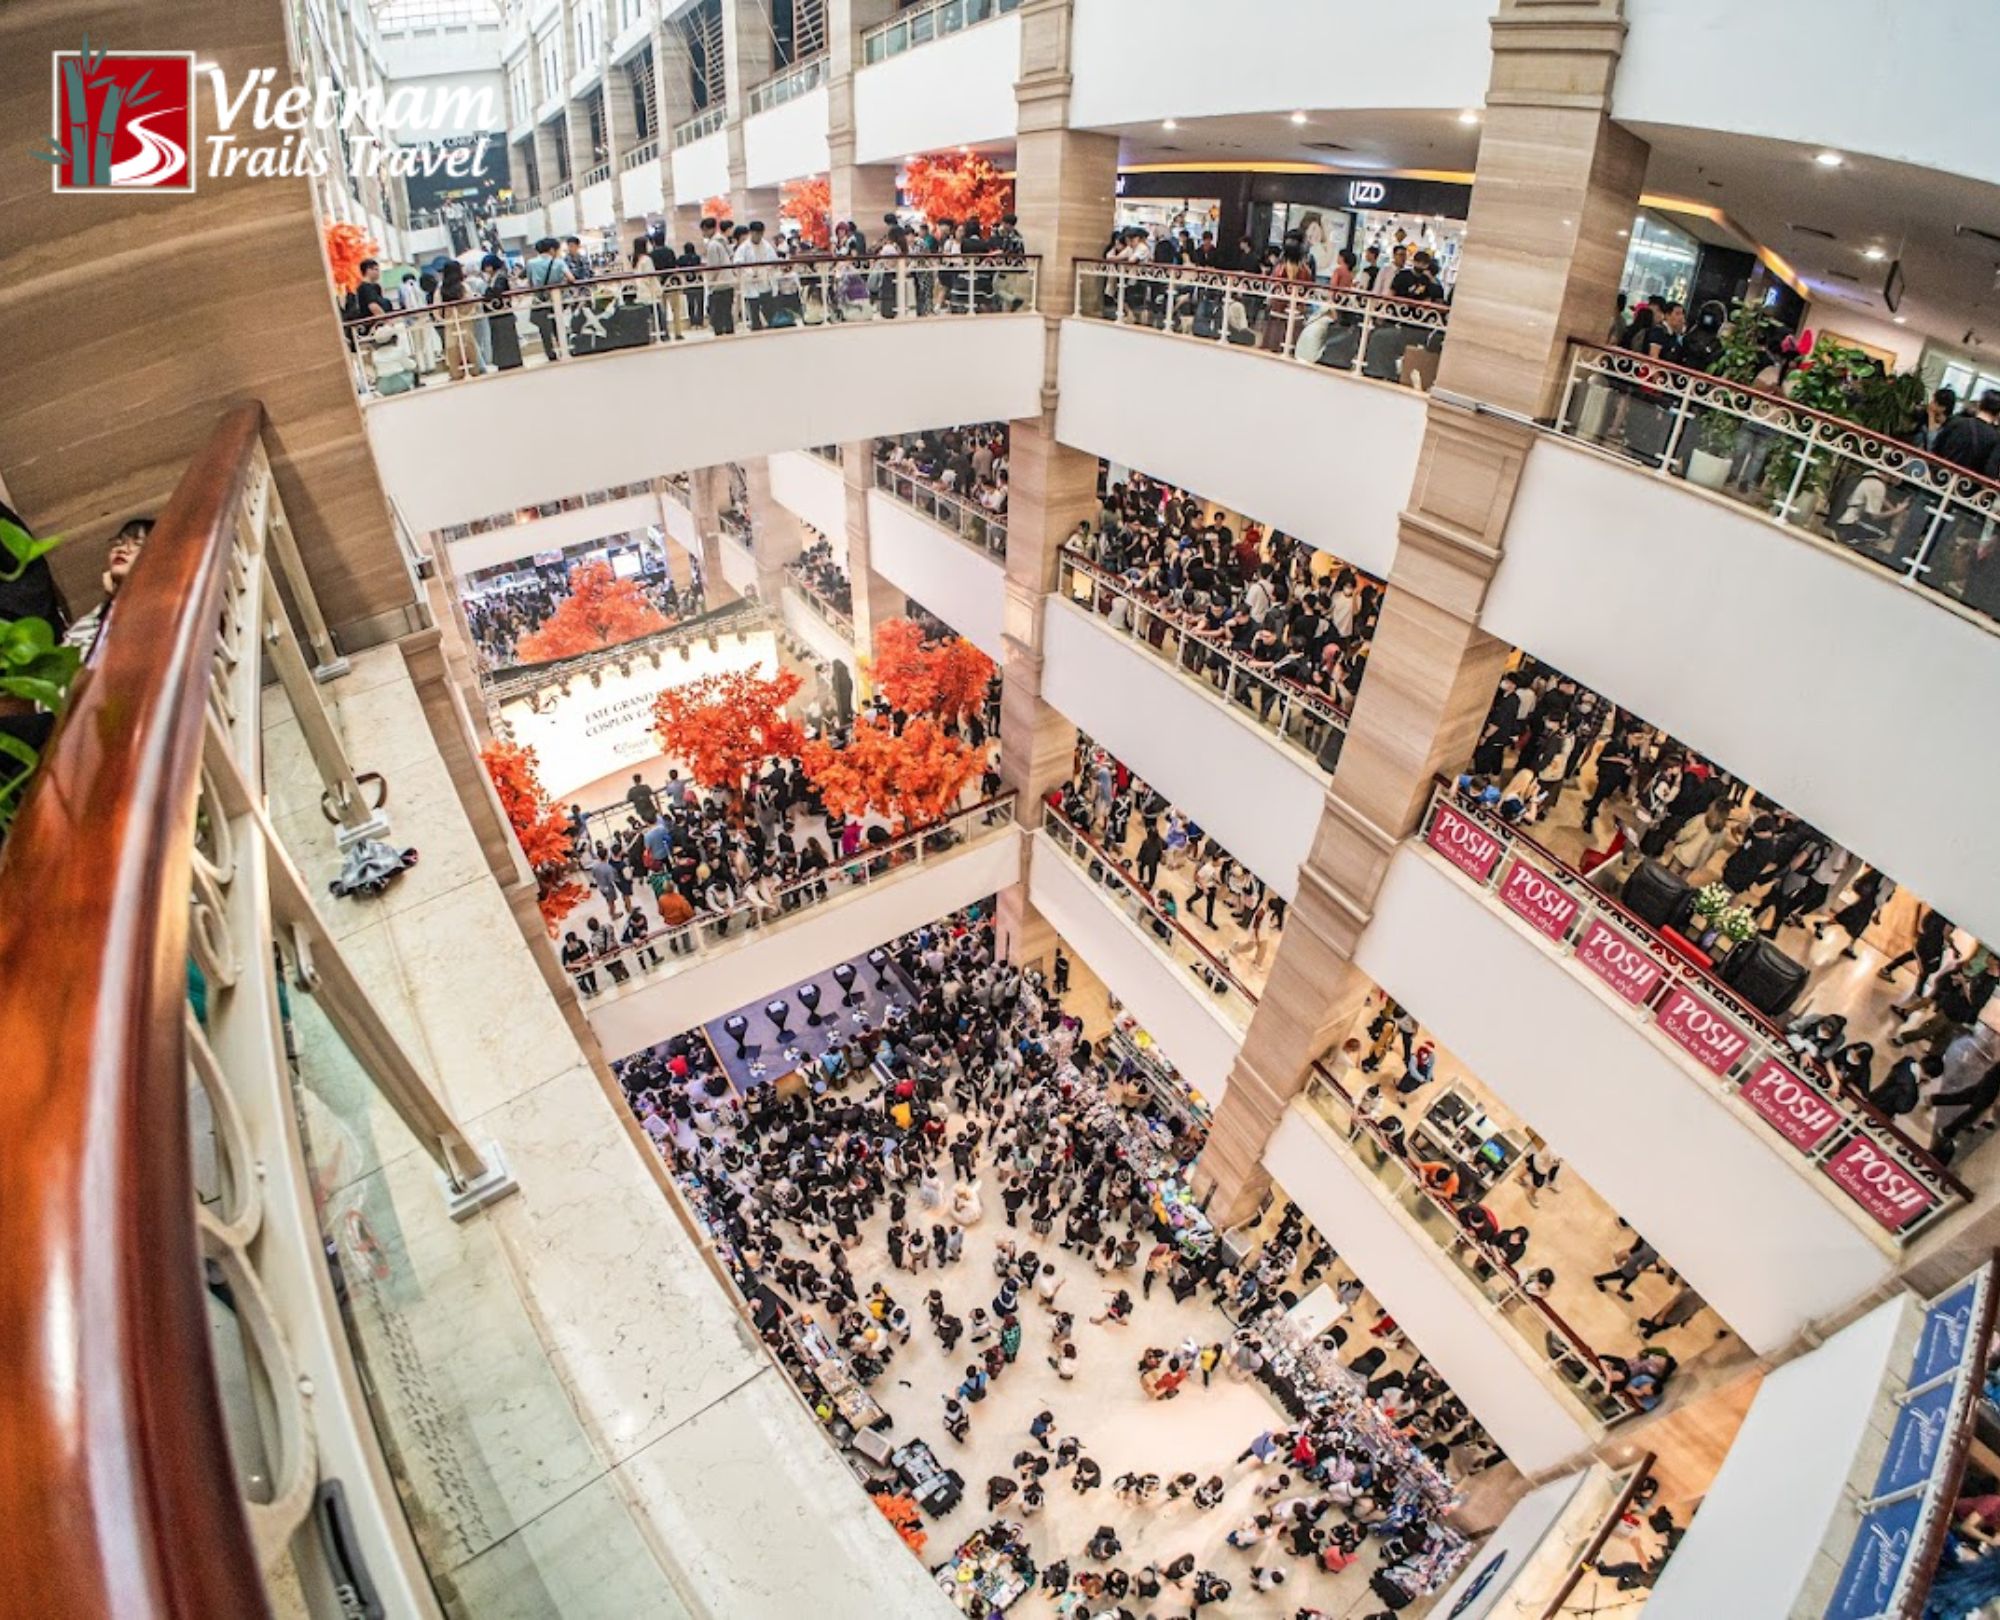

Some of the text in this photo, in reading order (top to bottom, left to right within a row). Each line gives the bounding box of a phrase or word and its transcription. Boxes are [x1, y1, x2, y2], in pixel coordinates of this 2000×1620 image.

[1439, 812, 1496, 862] POSH
[1507, 888, 1529, 911] Relax
[1537, 915, 1556, 932] style
[1511, 866, 1574, 922] POSH
[1583, 948, 1606, 973] Relax
[1615, 978, 1635, 996] style
[1589, 926, 1656, 986] POSH
[1664, 1015, 1690, 1043] Relax
[1699, 1048, 1720, 1067] style
[1672, 995, 1744, 1057] POSH
[1750, 1087, 1776, 1114] Relax
[1785, 1119, 1806, 1140] style
[1758, 1067, 1835, 1131] POSH
[1835, 1164, 1863, 1191] Relax
[1871, 1197, 1893, 1218] style
[1846, 1143, 1925, 1210] POSH
